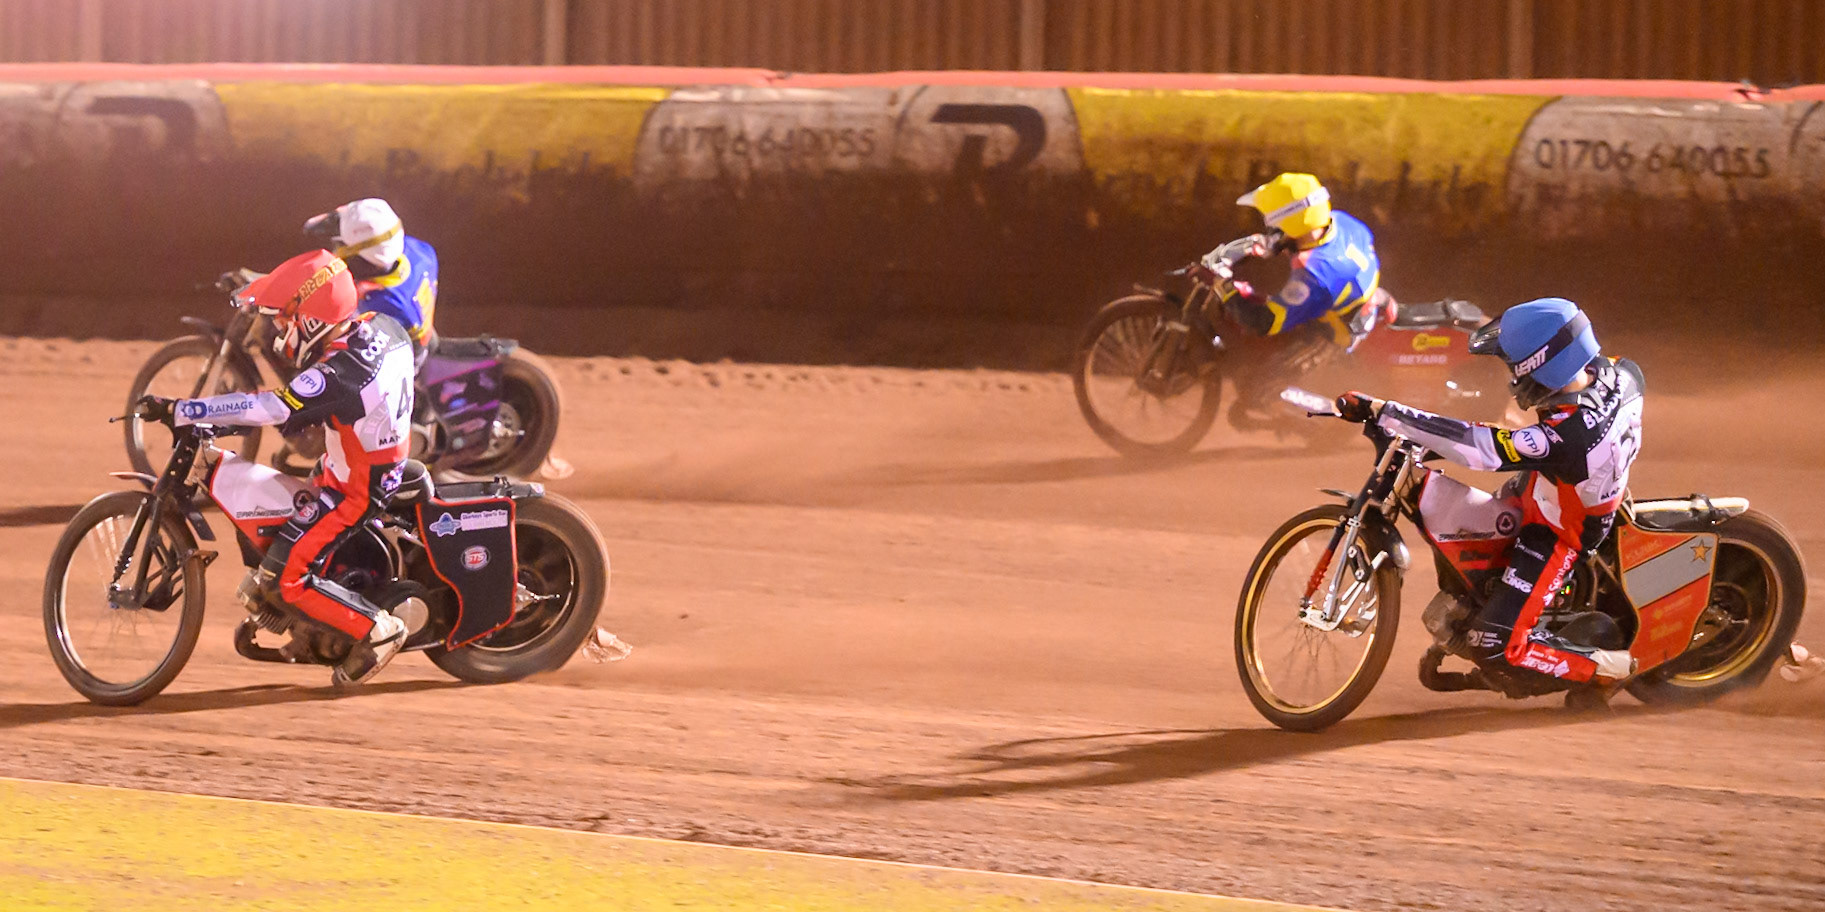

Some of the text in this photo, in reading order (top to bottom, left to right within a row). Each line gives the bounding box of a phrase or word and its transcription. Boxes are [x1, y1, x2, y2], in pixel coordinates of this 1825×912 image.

[1534, 138, 1771, 178] 01706 640055
[361, 329, 391, 362] COOK
[1515, 345, 1549, 377] LEATT
[1521, 430, 1541, 454] ATPI
